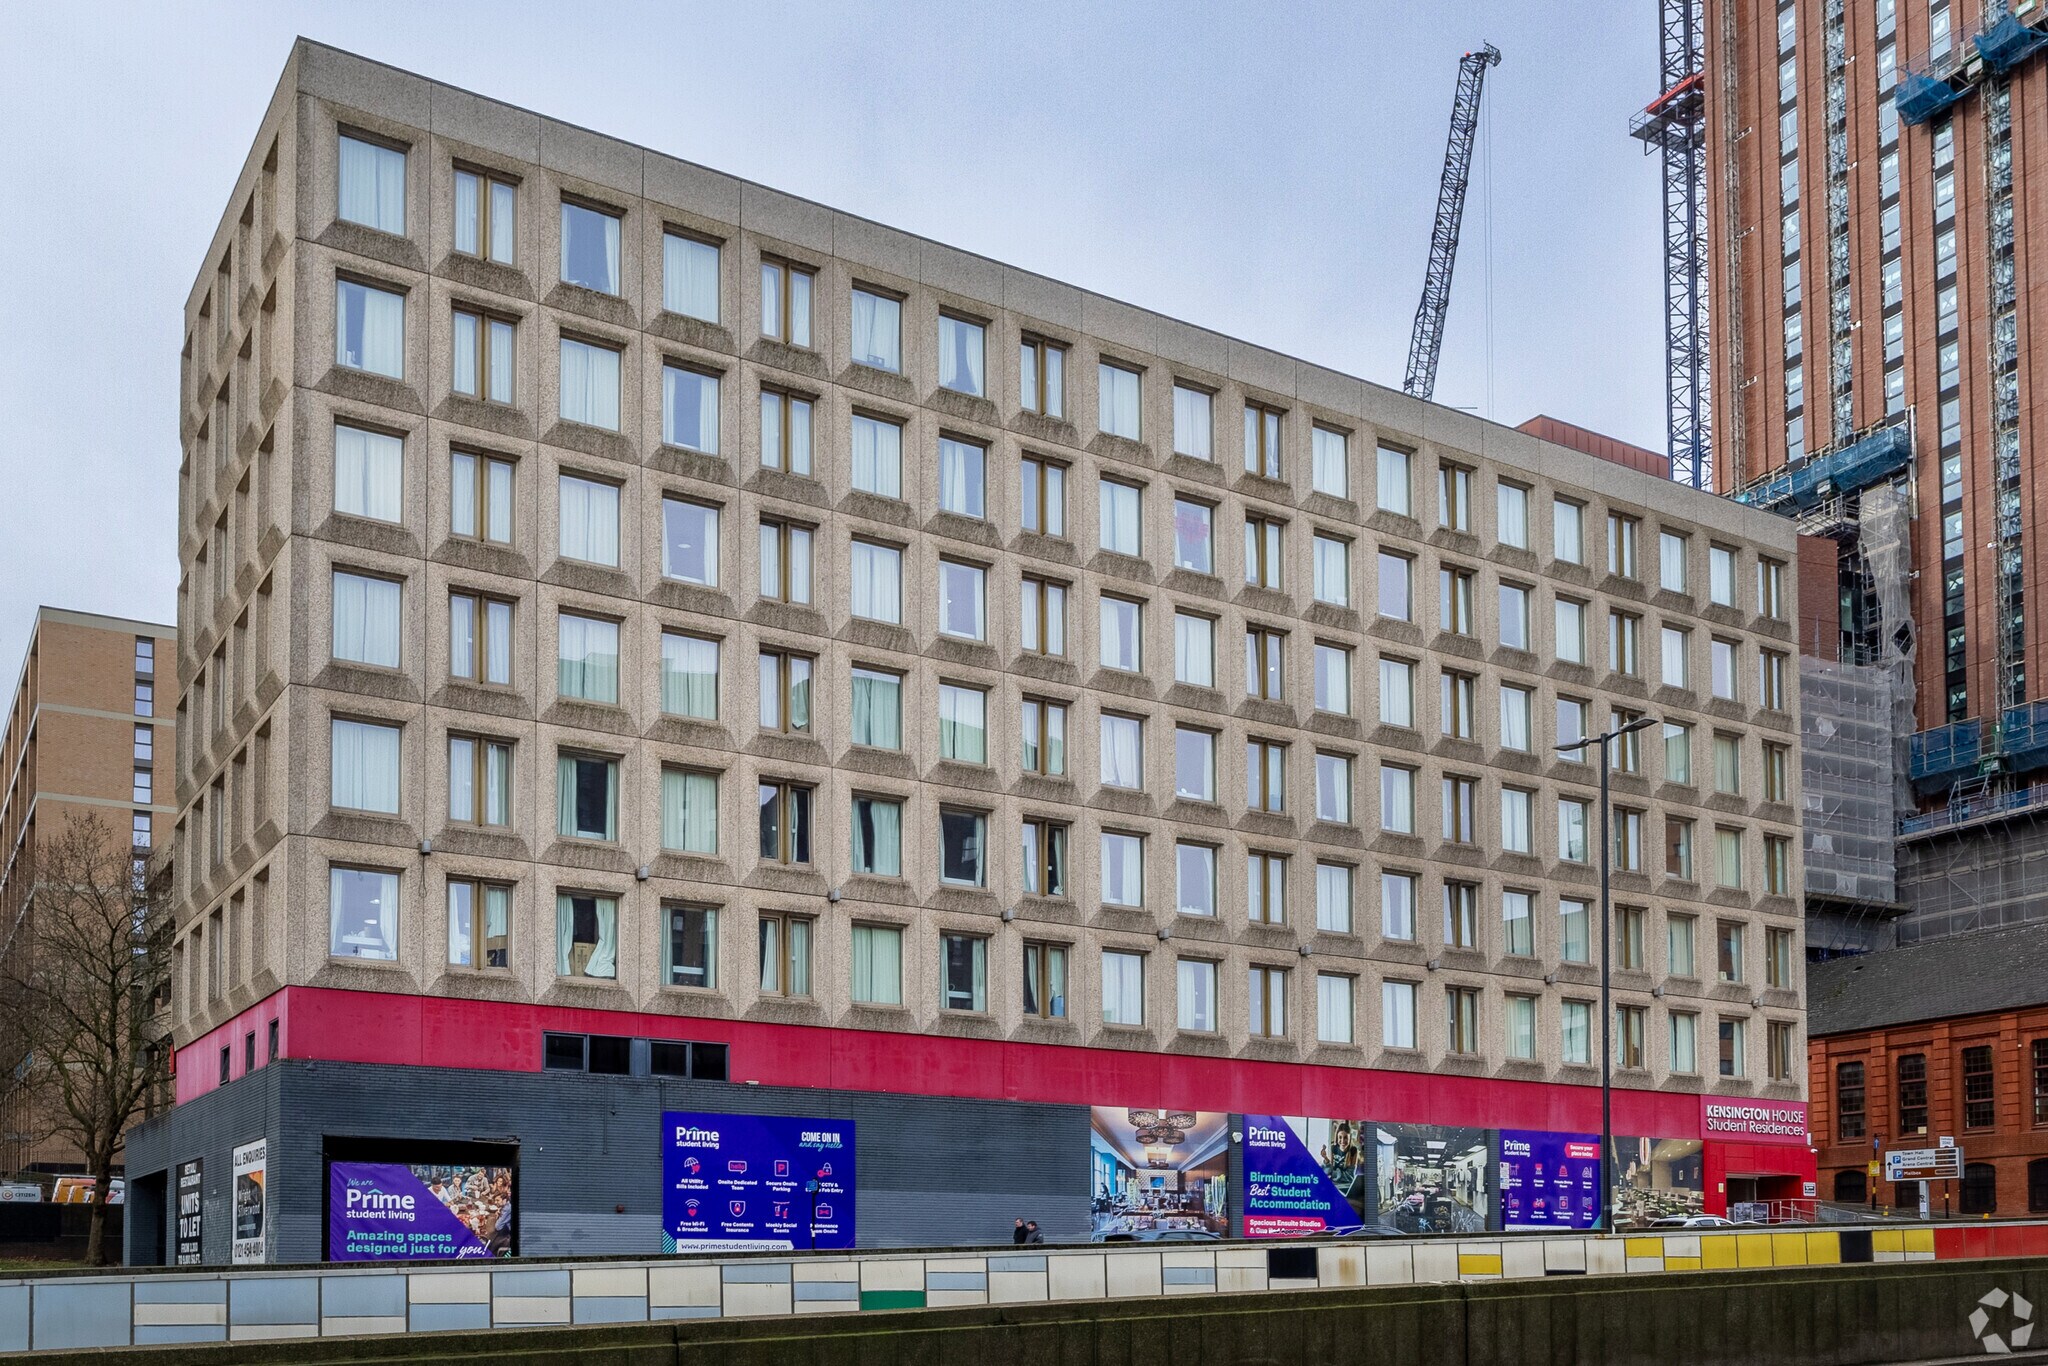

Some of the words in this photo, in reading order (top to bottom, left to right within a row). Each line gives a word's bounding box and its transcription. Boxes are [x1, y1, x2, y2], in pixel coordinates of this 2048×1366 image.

[1706, 1104, 1770, 1120] KENSINGTON
[1772, 1110, 1804, 1124] HOUSE
[676, 1126, 720, 1142] Prime
[1249, 1126, 1286, 1141] Prime
[1707, 1118, 1746, 1132] Student
[1749, 1121, 1804, 1136] Residences
[802, 1132, 821, 1142] COME
[822, 1132, 832, 1143] ON
[832, 1133, 840, 1144] IN
[702, 1141, 720, 1150] living
[1504, 1140, 1530, 1151] Prime
[243, 1146, 265, 1165] ENQUIRIES
[347, 1178, 359, 1187] We
[1250, 1172, 1319, 1186] Birmingham's
[1249, 1184, 1270, 1196] Best
[1271, 1186, 1311, 1198] Student
[181, 1191, 199, 1215] UNITS
[346, 1188, 415, 1210] Prime
[1250, 1198, 1330, 1210] Accommodation
[346, 1210, 386, 1219] student
[388, 1210, 415, 1221] living
[180, 1218, 188, 1238] TO
[188, 1216, 201, 1237] LET
[347, 1230, 404, 1242] Amazing
[408, 1232, 452, 1242] spaces
[347, 1243, 406, 1255] designed
[410, 1244, 434, 1256] just
[437, 1243, 457, 1254] for
[456, 1240, 491, 1259] you!
[681, 1242, 788, 1251] www.primestudentliving.com
